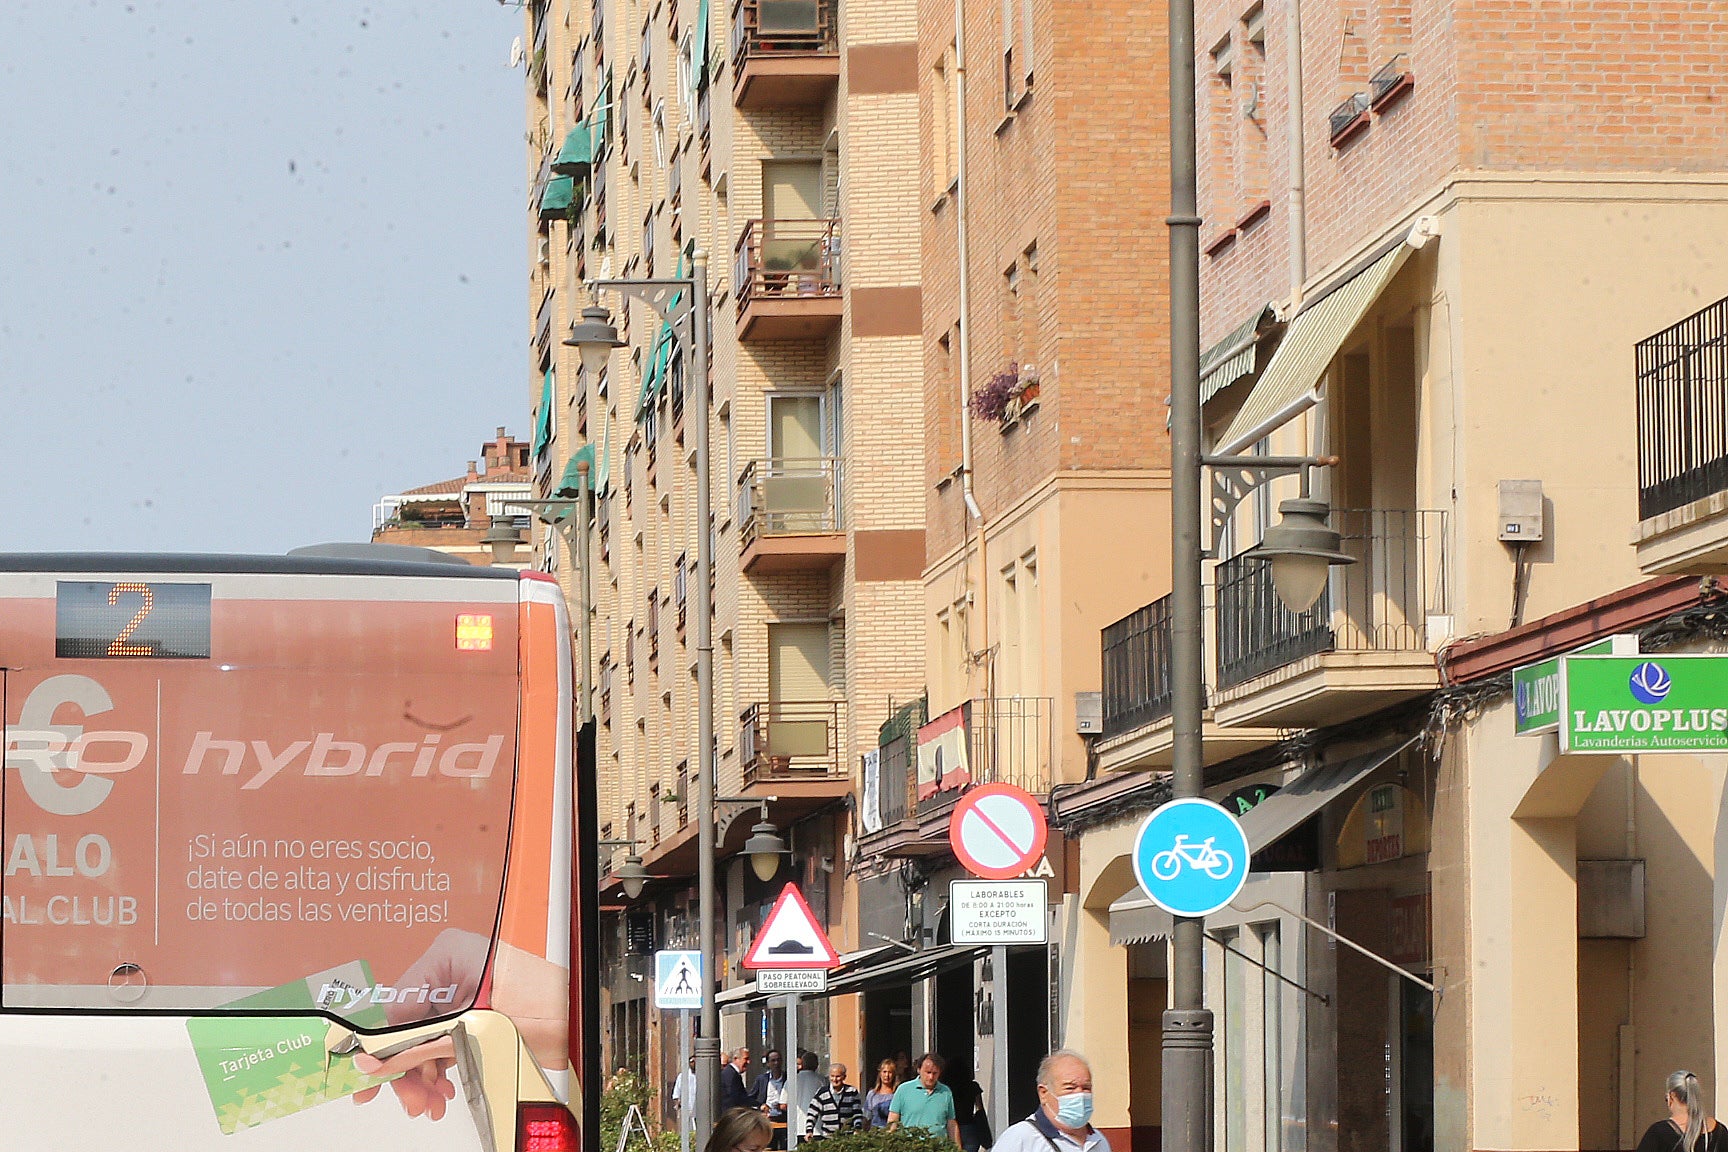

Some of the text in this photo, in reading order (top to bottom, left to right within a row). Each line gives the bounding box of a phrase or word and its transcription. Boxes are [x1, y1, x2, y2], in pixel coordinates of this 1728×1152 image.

[107, 582, 153, 657] 2
[1574, 708, 1728, 732] LAVOPLUS
[182, 731, 505, 790] hybrid
[188, 833, 436, 863] ¡Si aún no eres socio,
[186, 865, 451, 896] date de alta y disfruta
[970, 890, 1025, 899] LABORABLES
[46, 895, 139, 926] CLUB
[186, 896, 449, 928] de todas las ventajas!
[979, 910, 1017, 918] EXCEPTO
[317, 983, 459, 1010] hybrid
[763, 981, 819, 989] SOBREELEVADO
[219, 1033, 313, 1076] Tarjeta Club
